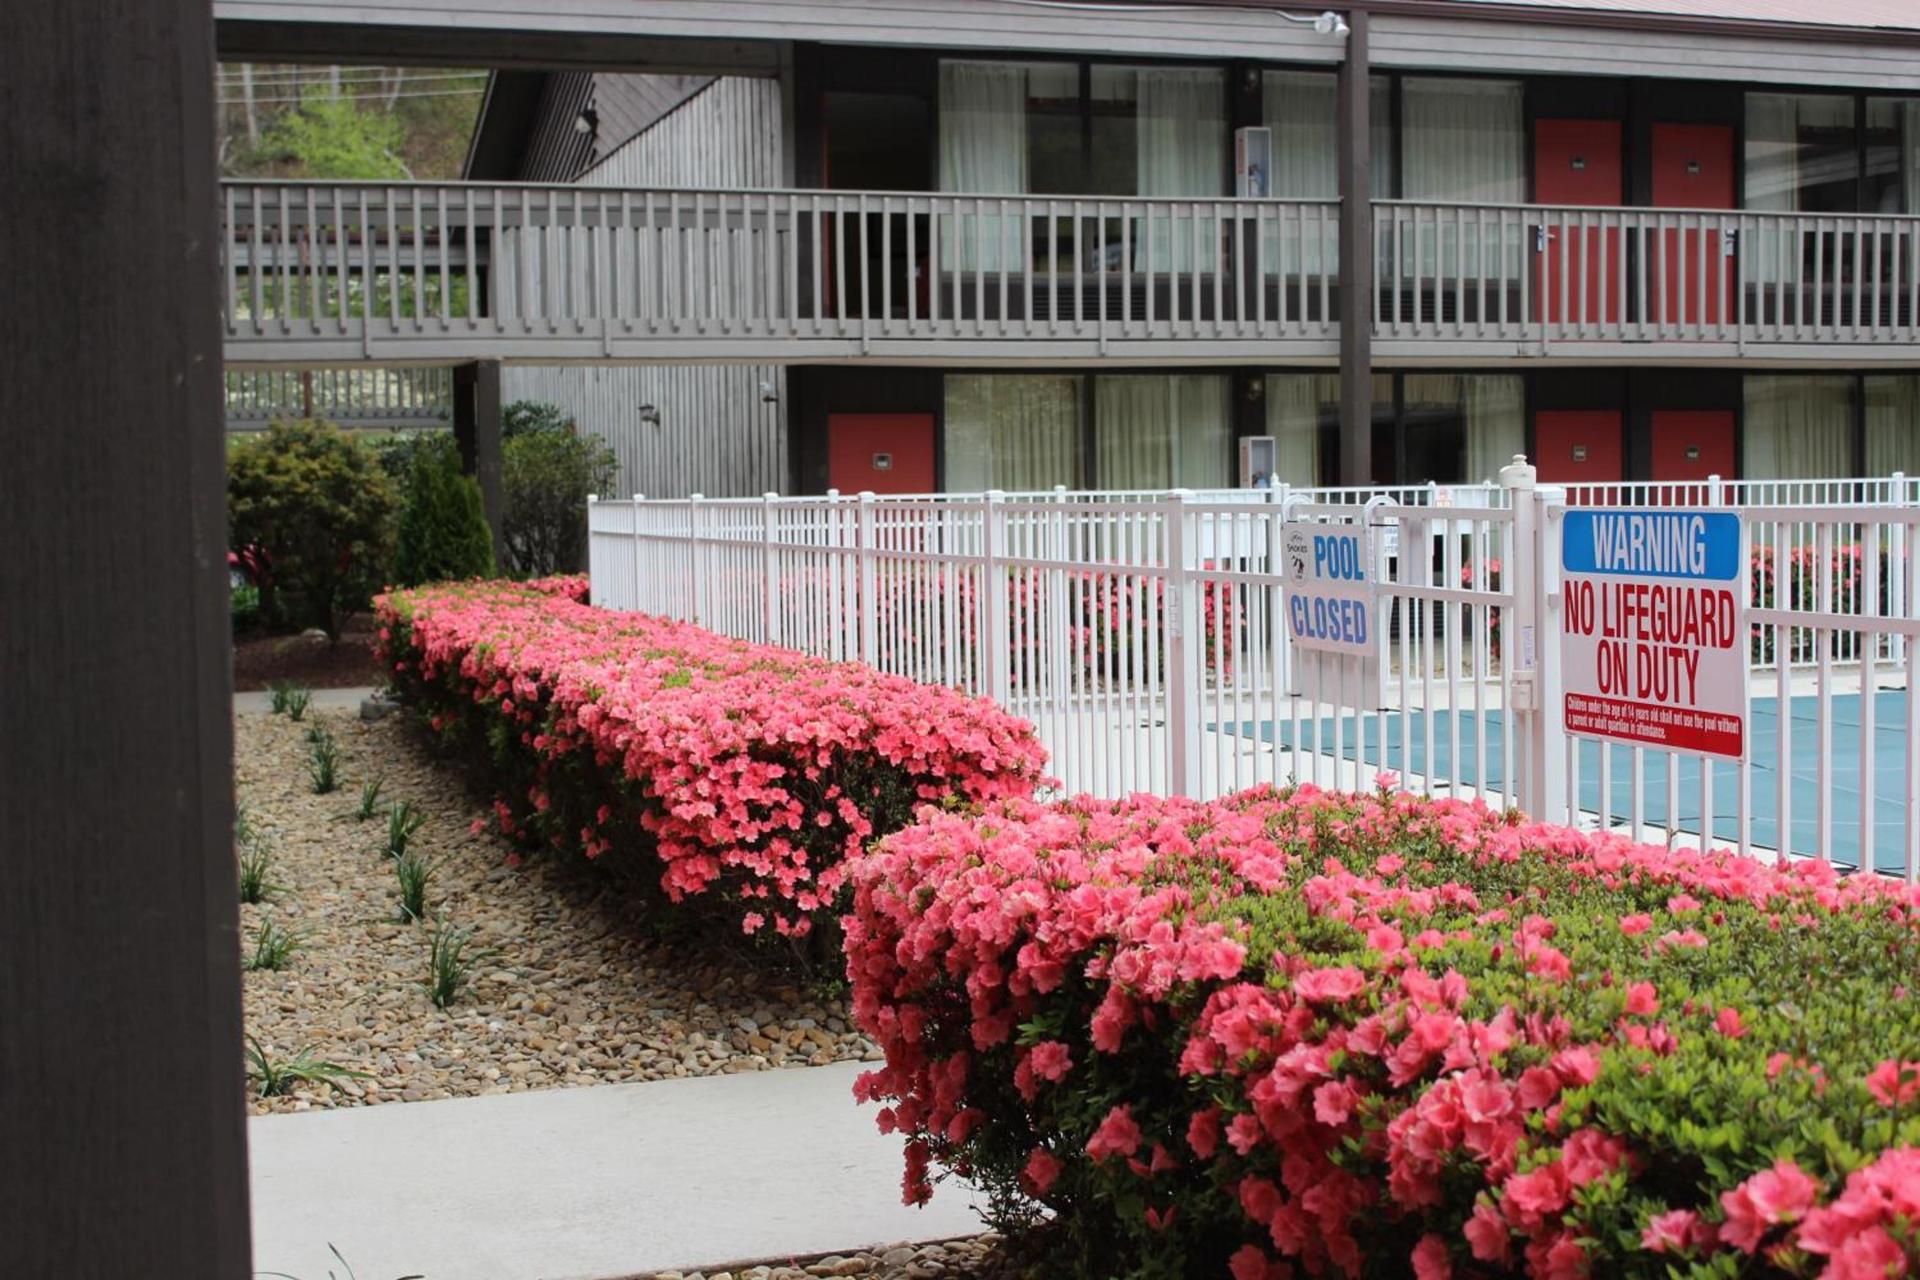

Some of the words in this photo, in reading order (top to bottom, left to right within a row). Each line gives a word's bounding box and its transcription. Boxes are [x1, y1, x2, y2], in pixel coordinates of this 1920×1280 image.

[1313, 535, 1364, 581] POOL
[1592, 514, 1705, 575] WARNING
[1290, 594, 1367, 645] CLOSED
[1565, 580, 1594, 636] NO
[1602, 582, 1735, 649] LIFEGUARD
[1597, 639, 1628, 697] ON
[1636, 642, 1700, 706] DUTY
[1572, 714, 1588, 728] parent
[1588, 716, 1594, 727] or
[1594, 715, 1607, 730] adult
[1608, 718, 1630, 734] guardian
[1630, 719, 1636, 734] in
[1588, 699, 1602, 714] under
[1602, 701, 1611, 715] the
[1611, 704, 1621, 719] age
[1621, 704, 1628, 717] of
[1627, 704, 1634, 718] 14
[1635, 707, 1649, 722] years
[1650, 707, 1658, 722] old
[1659, 709, 1672, 724] shall
[1673, 711, 1683, 726] not
[1683, 714, 1693, 728] use
[1694, 713, 1704, 729] the
[1704, 716, 1717, 733] pool
[1717, 717, 1739, 735] without
